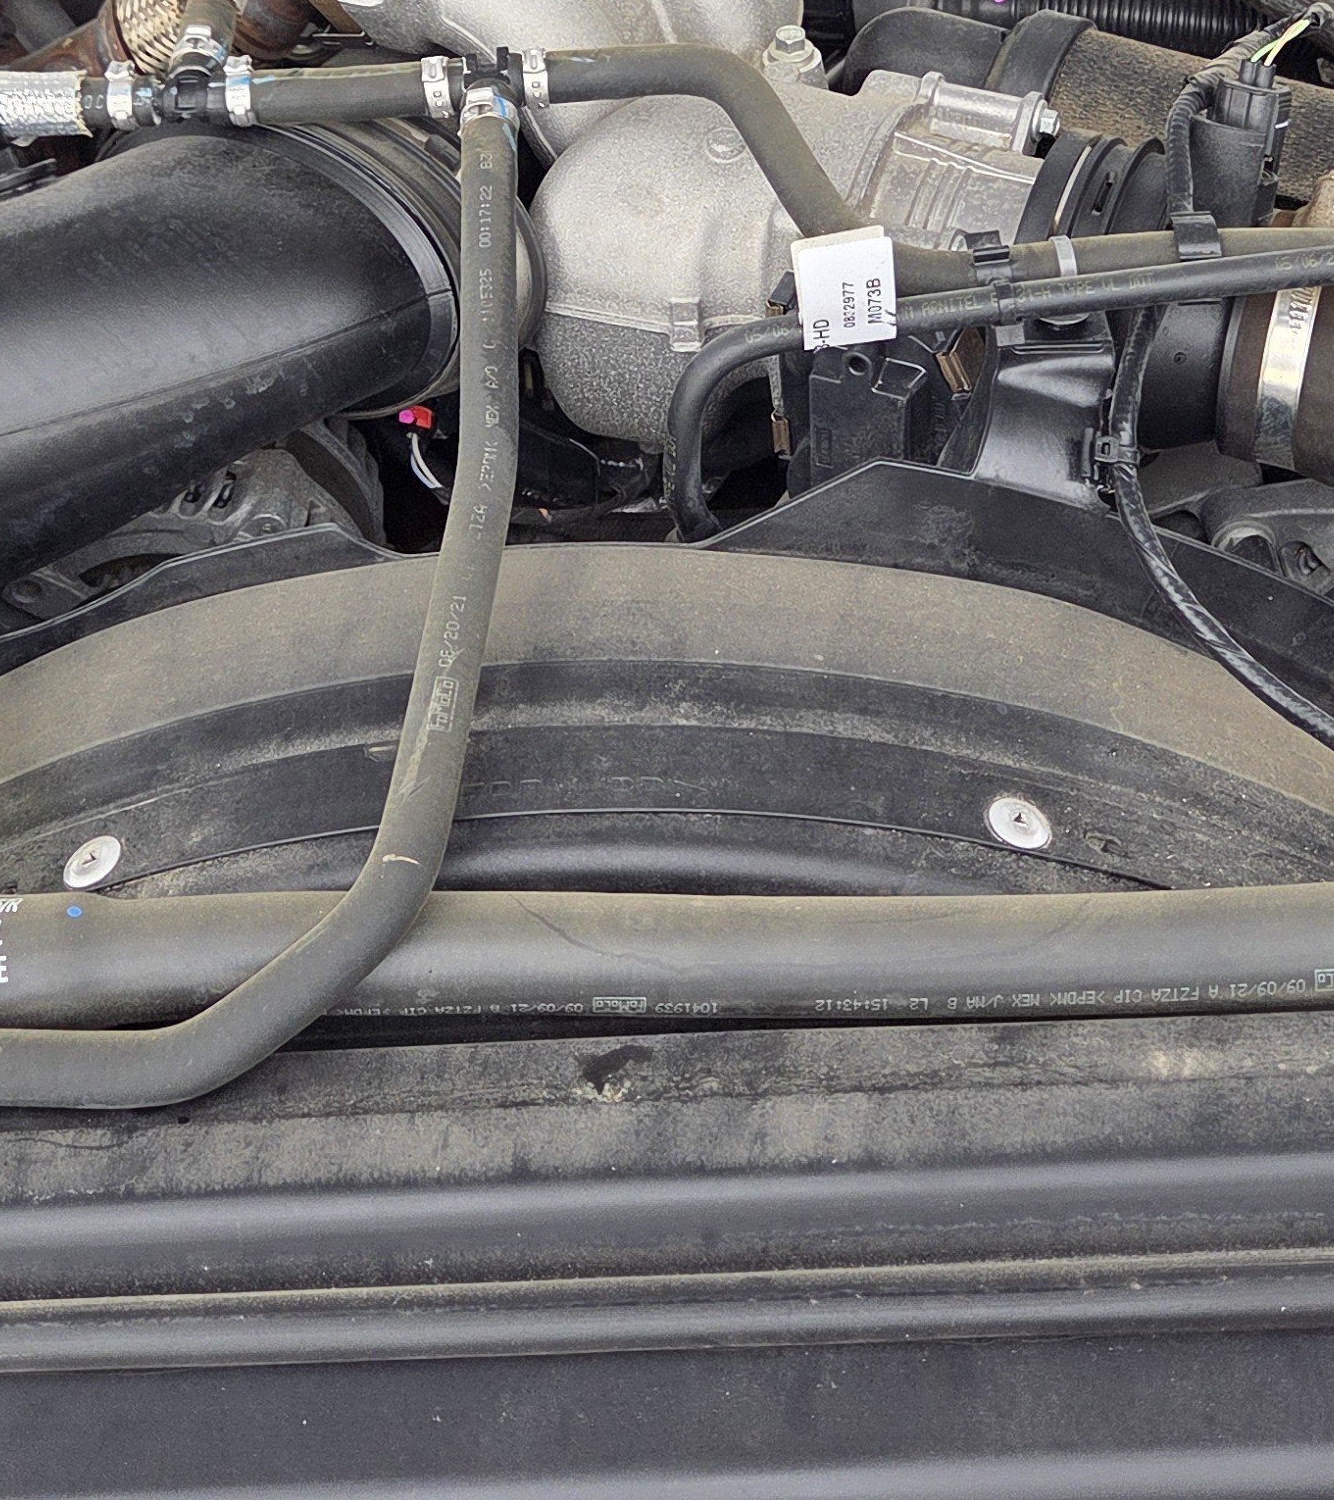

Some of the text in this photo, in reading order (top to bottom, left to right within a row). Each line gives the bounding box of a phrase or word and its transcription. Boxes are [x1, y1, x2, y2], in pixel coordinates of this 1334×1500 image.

[478, 184, 495, 247] 00:17:22
[867, 277, 882, 325] M073B
[1230, 978, 1306, 997] 09/09/21
[814, 997, 889, 1011] 15:43:12
[1012, 992, 1040, 1006] MEX
